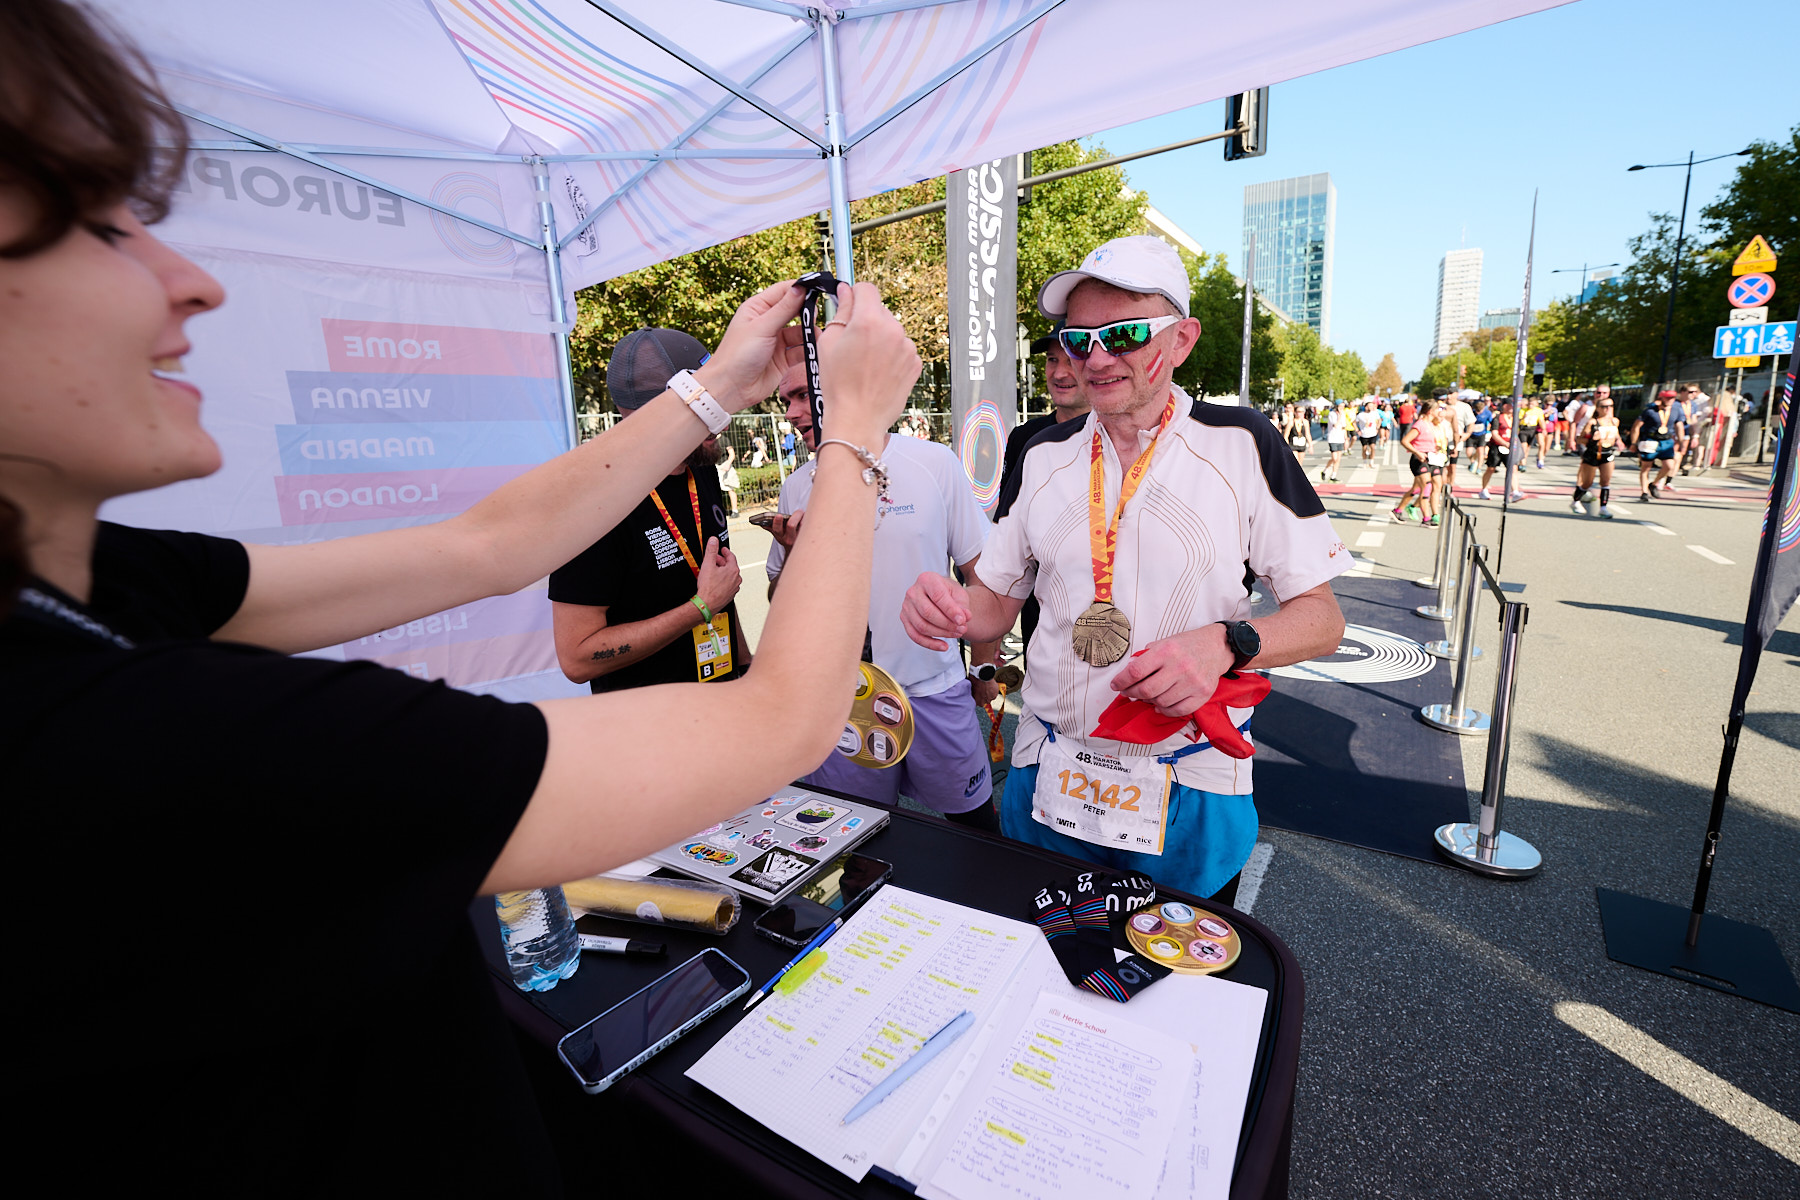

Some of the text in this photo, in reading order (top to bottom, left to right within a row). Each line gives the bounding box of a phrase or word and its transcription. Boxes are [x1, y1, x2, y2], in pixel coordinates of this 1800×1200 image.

[967, 253, 986, 381] EUROPEAN
[703, 665, 712, 677] B
[1075, 751, 1093, 765] 48.
[1057, 769, 1142, 812] 12142
[1083, 803, 1106, 816] PETER
[1062, 1013, 1107, 1034] Hertie School
